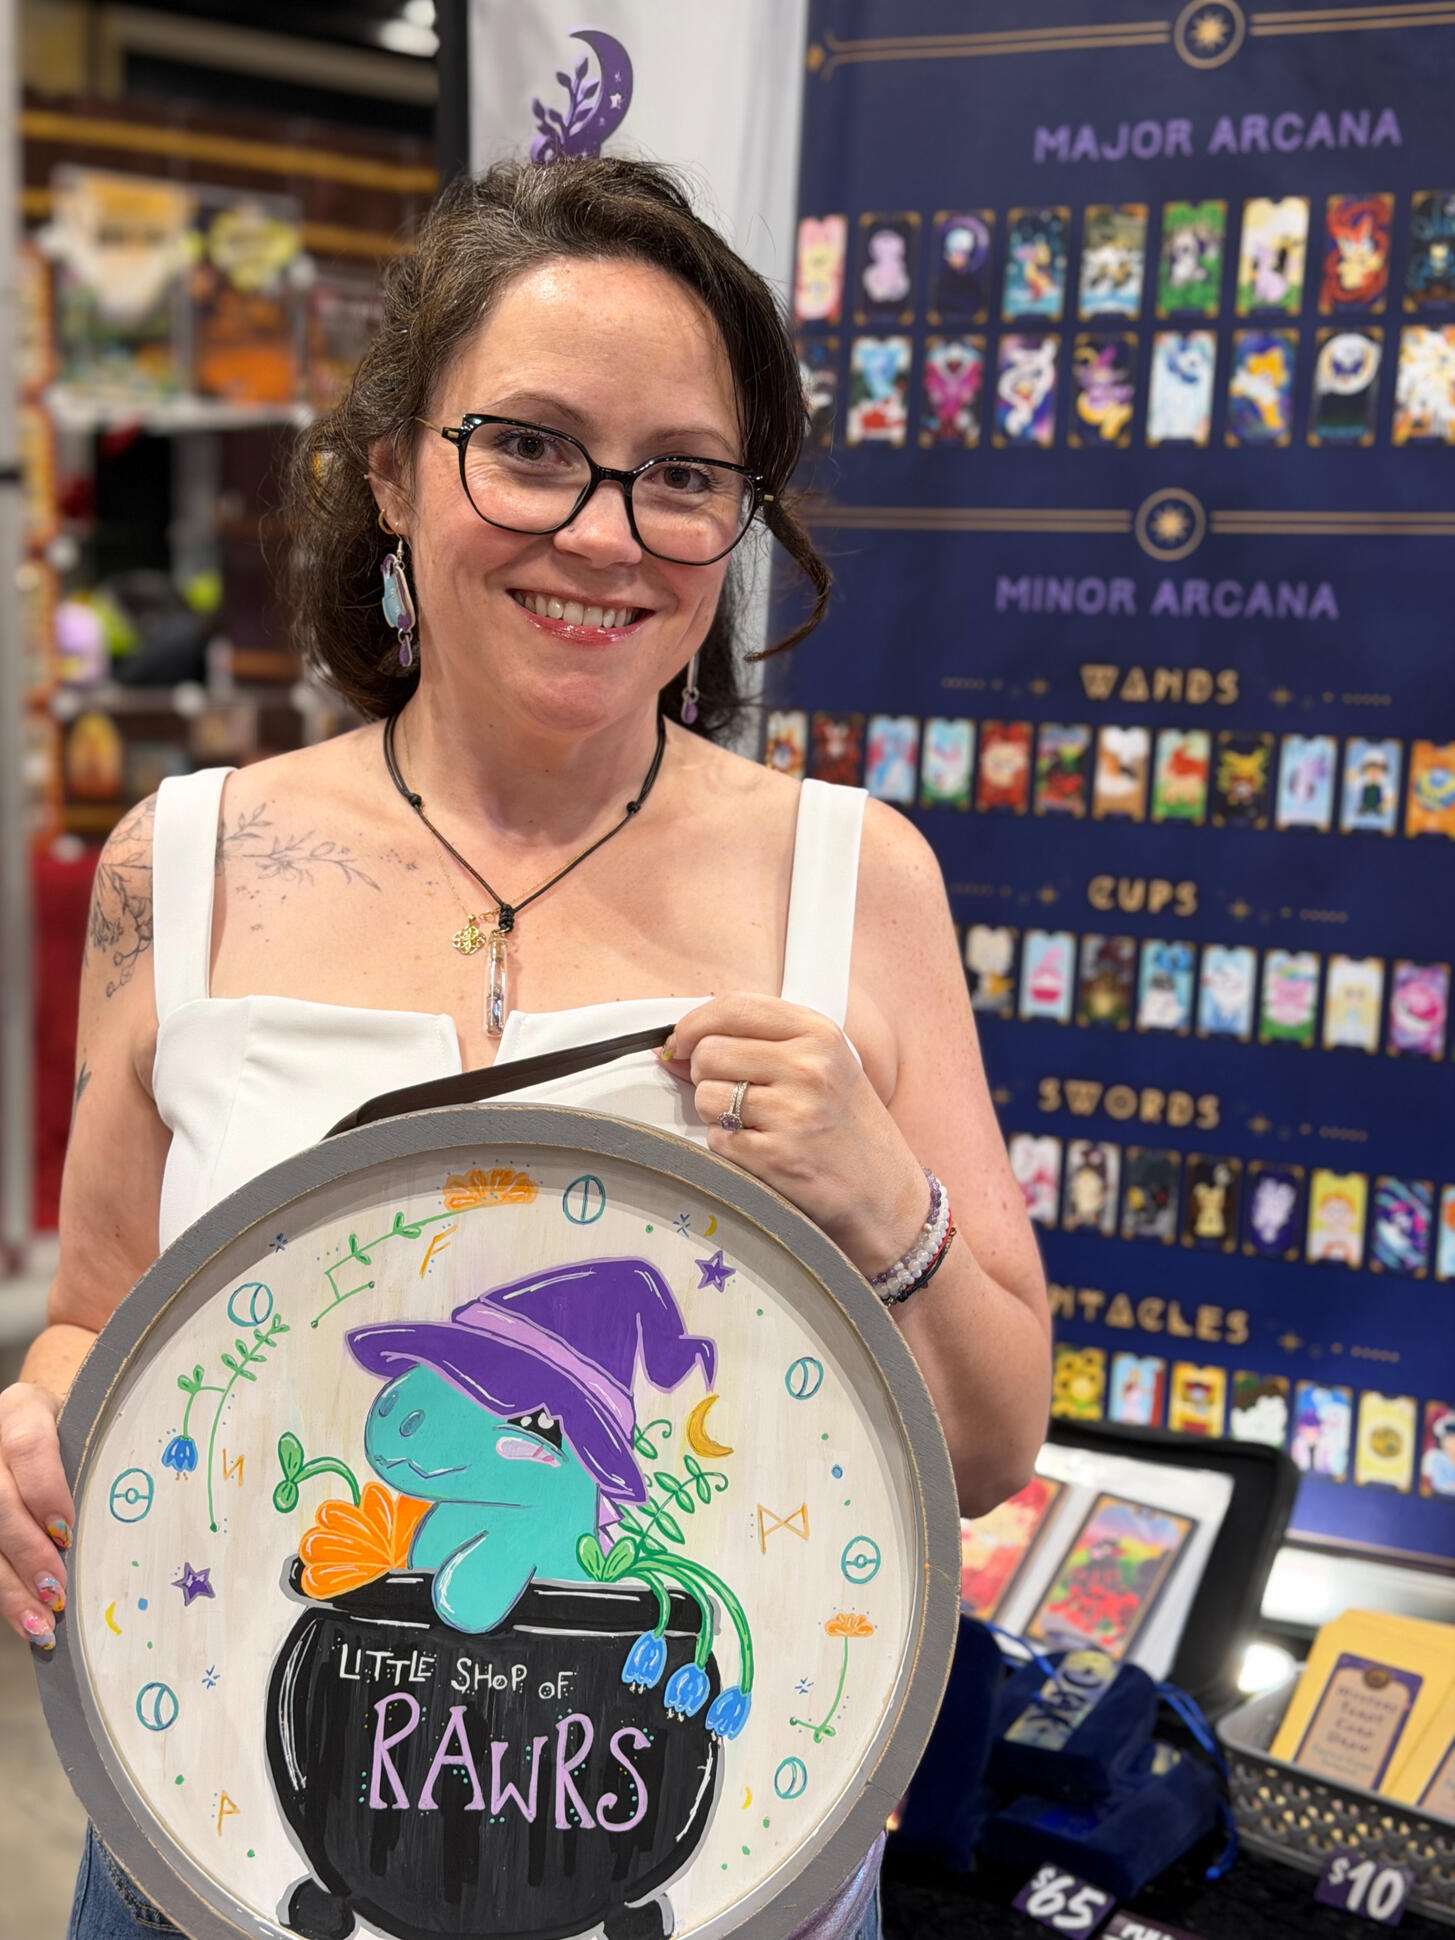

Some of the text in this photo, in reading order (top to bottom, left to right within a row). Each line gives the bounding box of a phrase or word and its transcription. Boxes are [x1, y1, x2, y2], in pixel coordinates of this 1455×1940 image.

[1033, 108, 1402, 162] MAJOR ARCANA
[996, 576, 1340, 619] MINOR ARCANA
[1080, 664, 1240, 705] WANDS
[1088, 875, 1199, 916] CUPS
[1037, 1077, 1221, 1130] SWORDS
[1047, 1282, 1250, 1346] NTACLES
[338, 1643, 574, 1700] LITTLE SHOP OF
[368, 1692, 652, 1832] RAWRS
[1026, 1866, 1107, 1929] $65
[1328, 1857, 1405, 1920] $10
